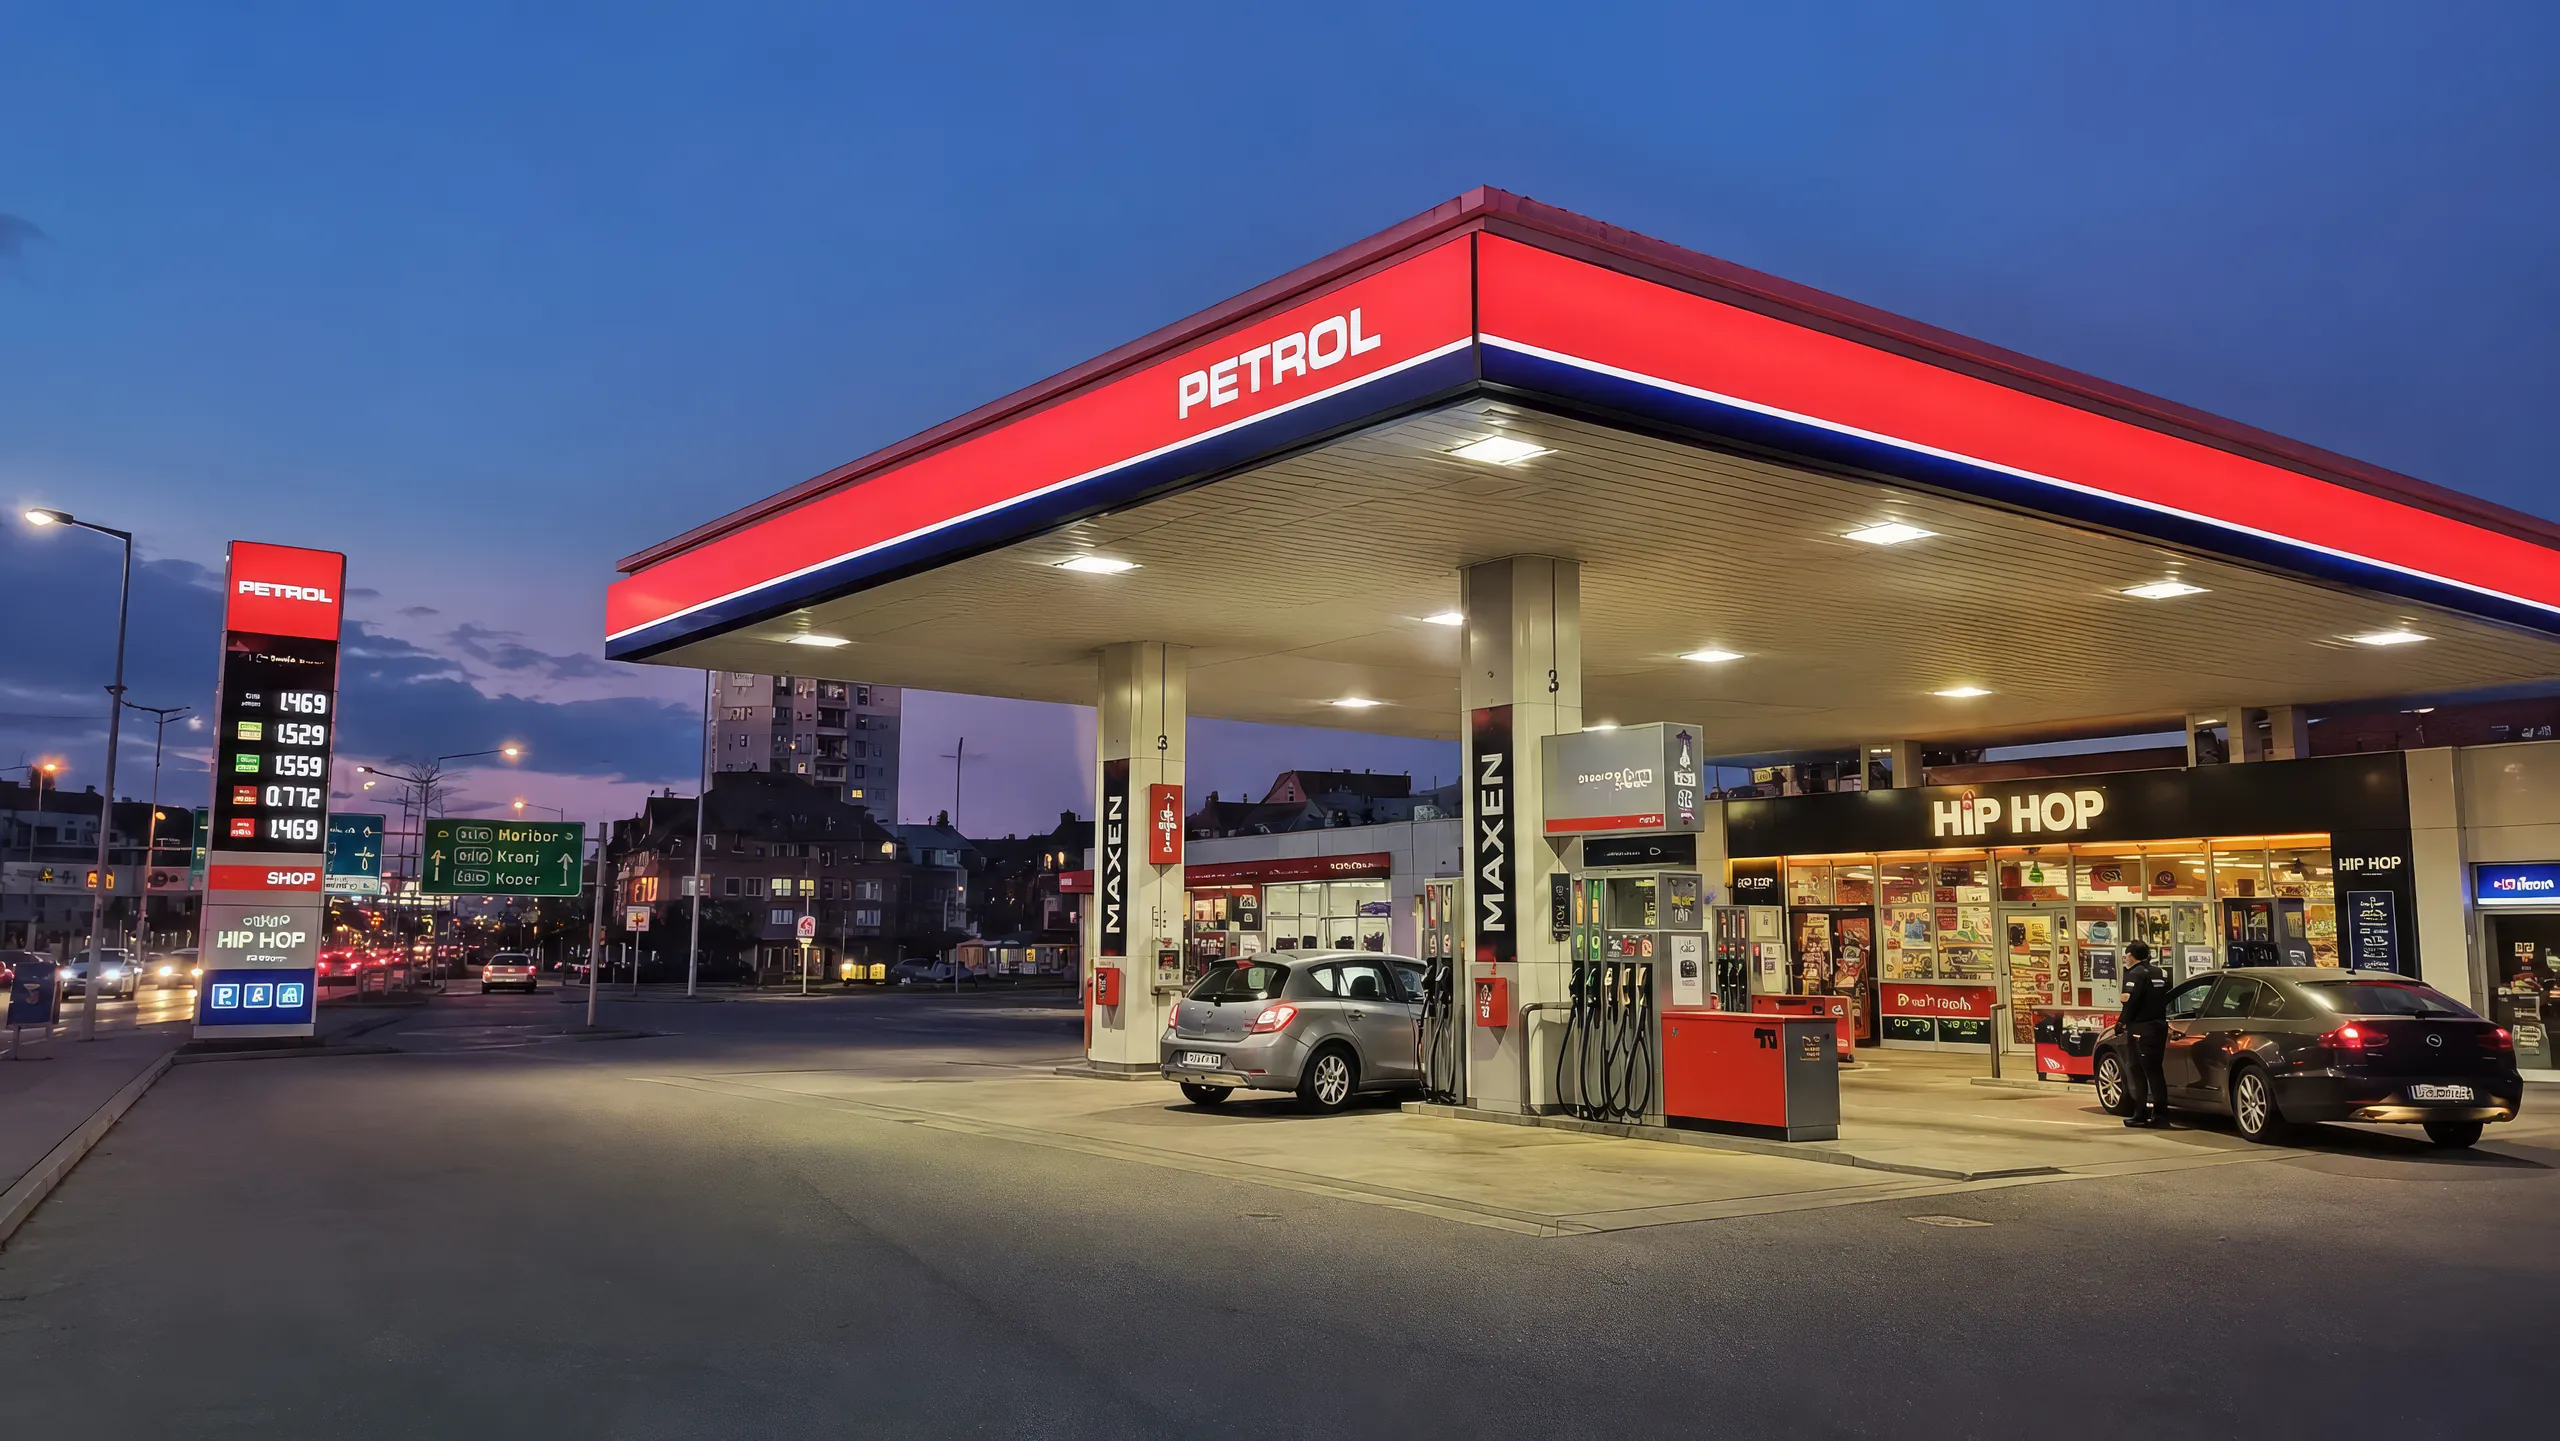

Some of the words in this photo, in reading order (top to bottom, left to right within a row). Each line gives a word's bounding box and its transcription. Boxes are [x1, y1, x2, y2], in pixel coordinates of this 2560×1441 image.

[1178, 307, 1381, 420] PETROL
[238, 580, 333, 603] PETROL
[266, 786, 320, 808] 0.772
[2010, 790, 2105, 834] HOP
[1481, 752, 1505, 932] MAXEN
[1106, 795, 1122, 933] MAXEN
[2339, 857, 2365, 872] HIP
[2368, 856, 2401, 871] HOP
[266, 871, 316, 885] SHOP
[217, 930, 254, 949] HIP
[259, 931, 306, 949] HOP
